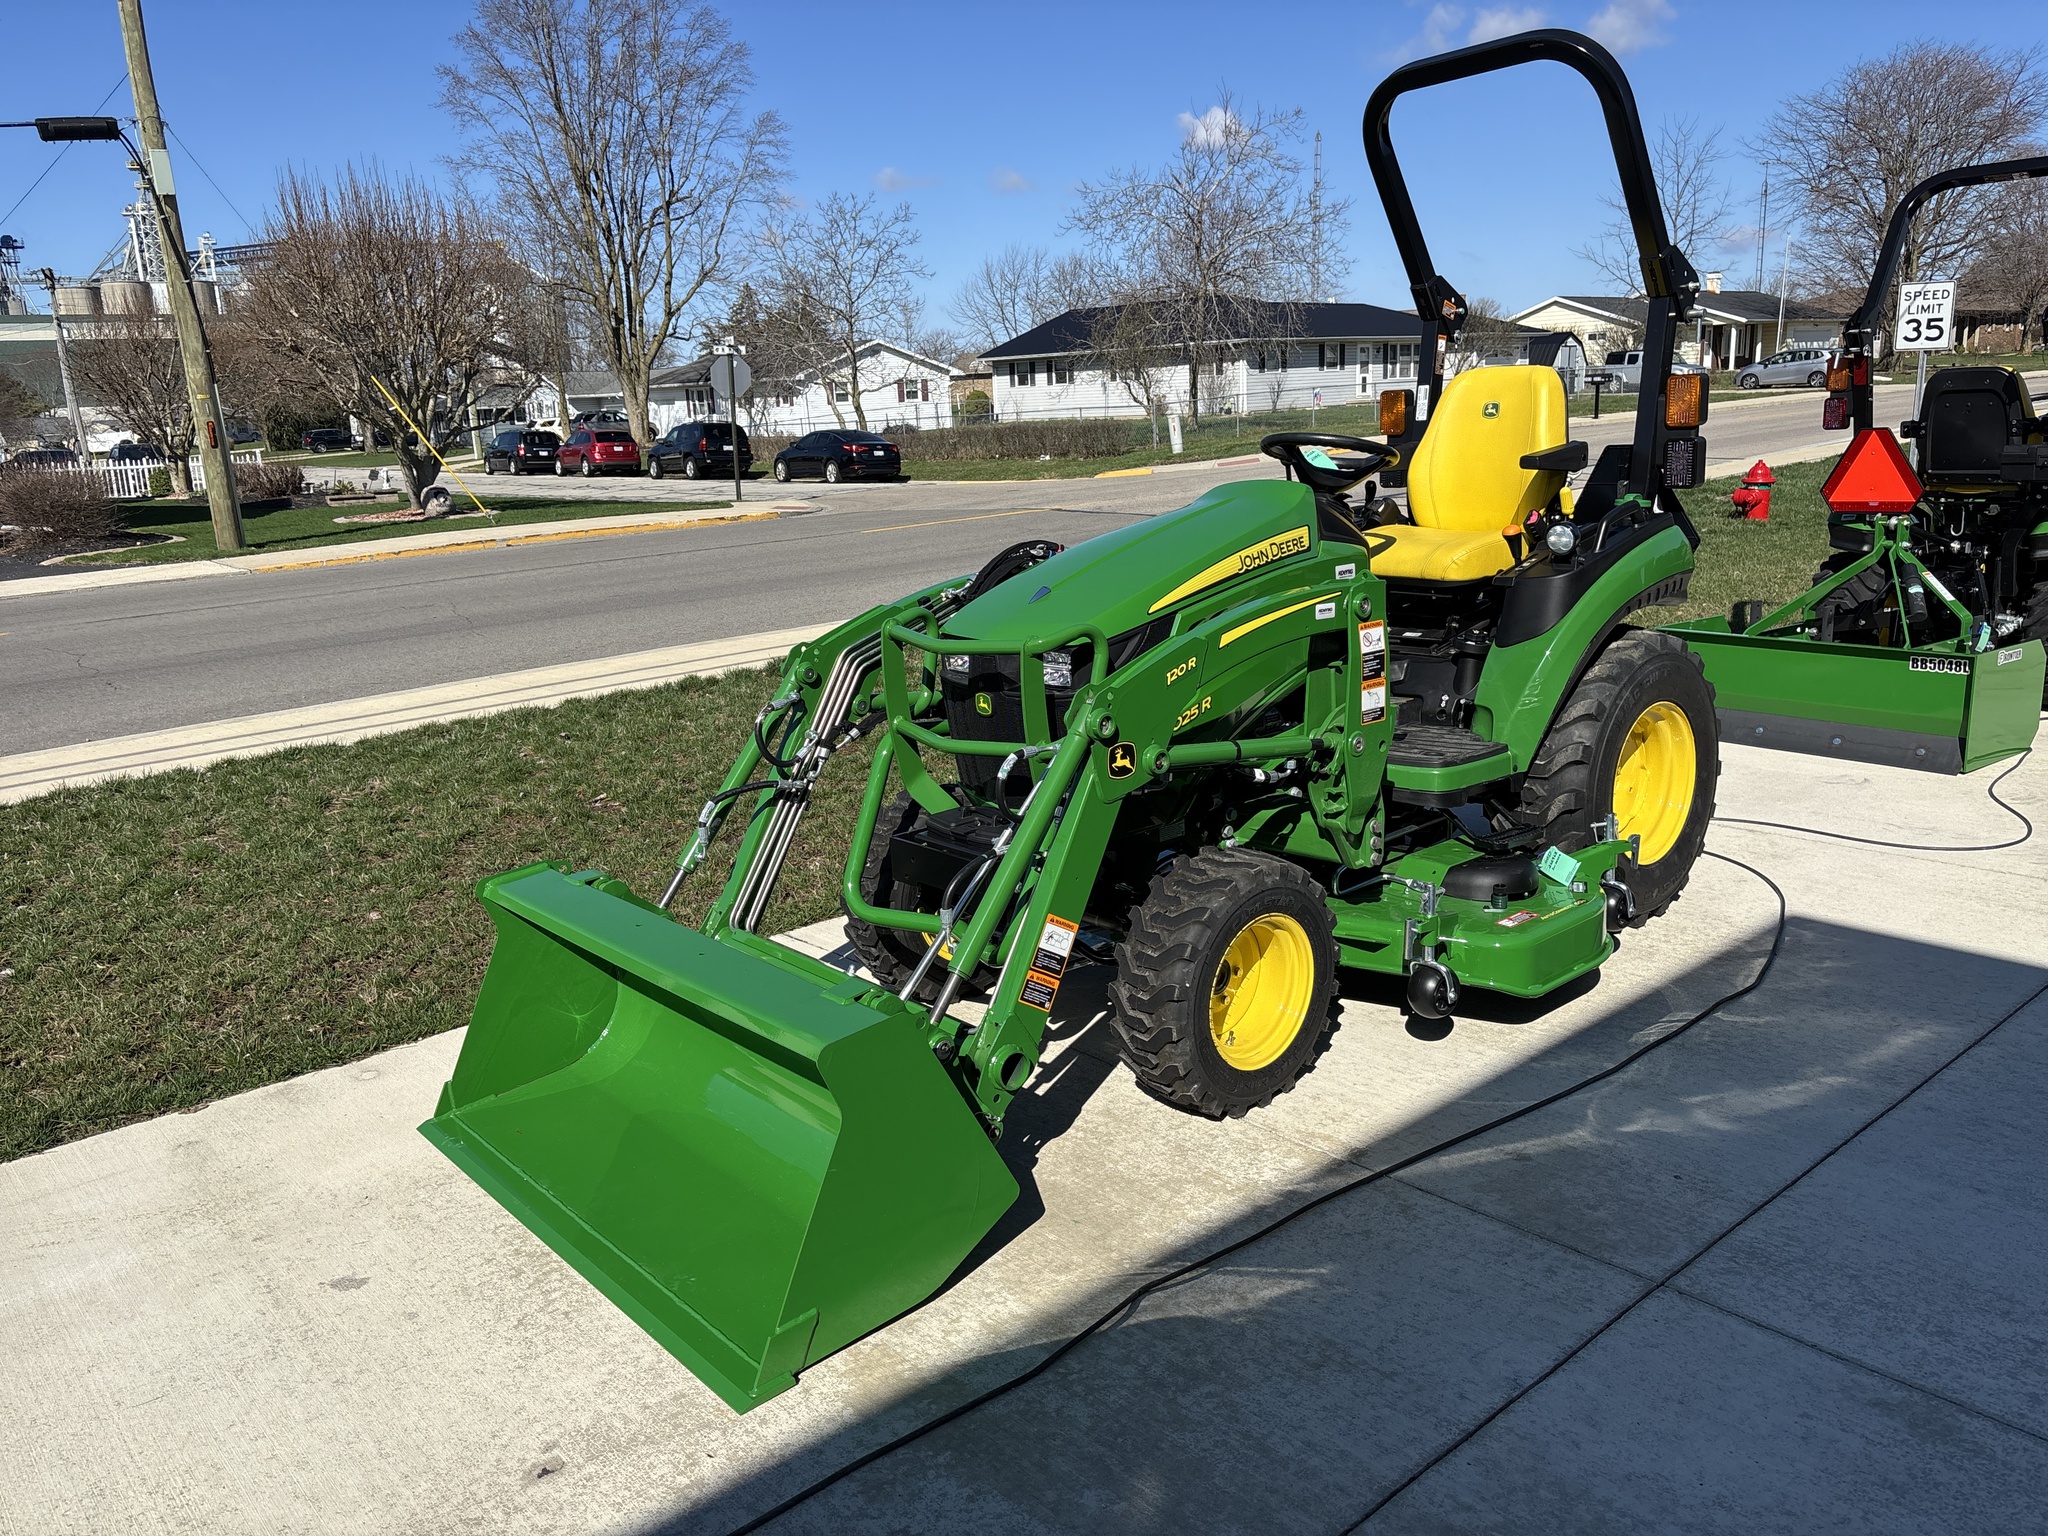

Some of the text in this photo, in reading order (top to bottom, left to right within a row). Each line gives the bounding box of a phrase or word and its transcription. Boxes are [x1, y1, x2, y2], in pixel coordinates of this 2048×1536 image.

[1904, 289, 1950, 301] SPEED
[1907, 303, 1943, 315] LIMIT
[1902, 317, 1944, 342] 35
[1238, 536, 1307, 573] JOHN DEERE
[1166, 657, 1197, 686] 120 R
[1911, 657, 1970, 674] BB5048L
[1201, 696, 1212, 713] R
